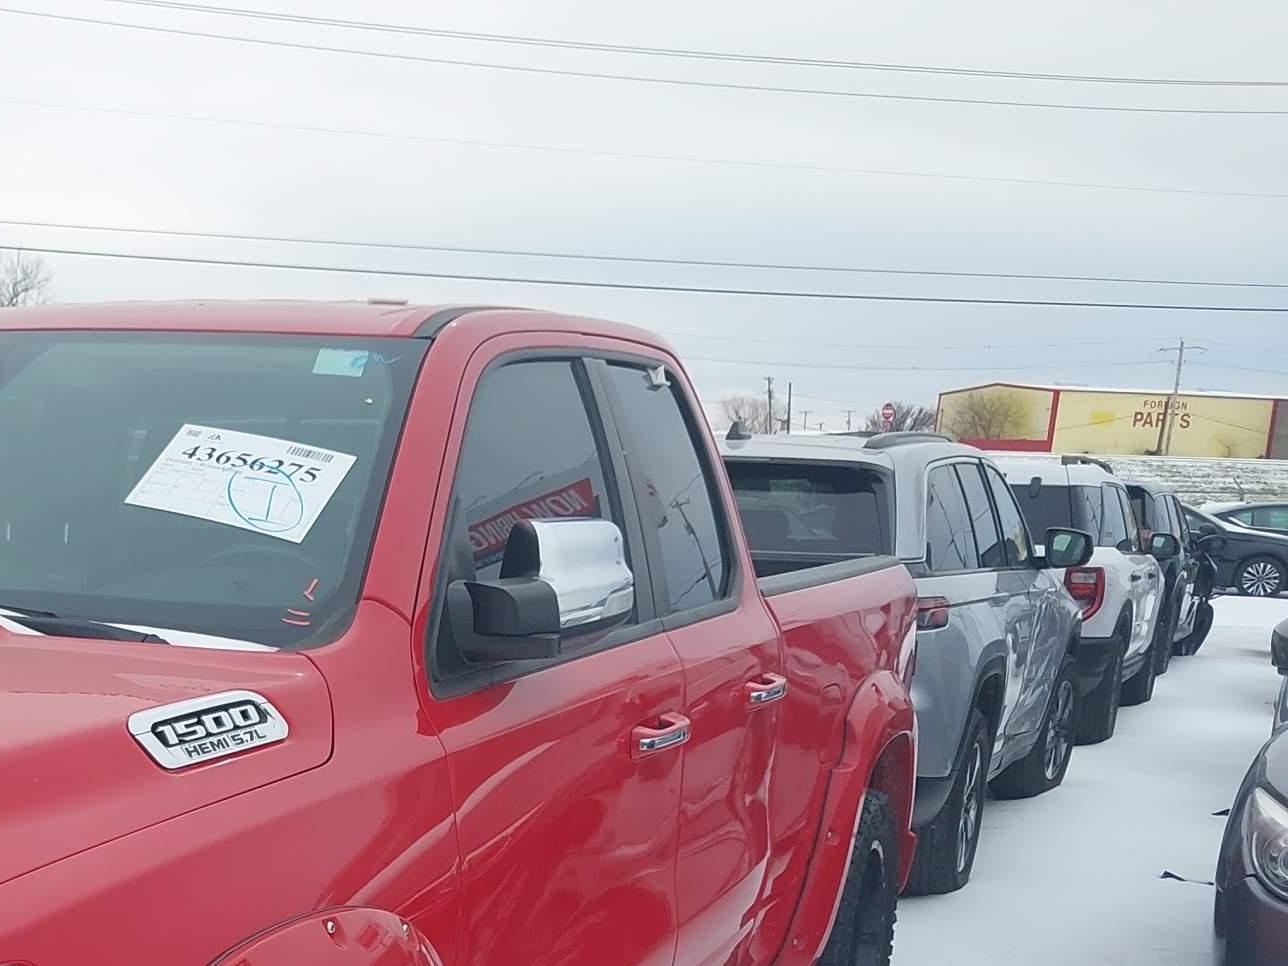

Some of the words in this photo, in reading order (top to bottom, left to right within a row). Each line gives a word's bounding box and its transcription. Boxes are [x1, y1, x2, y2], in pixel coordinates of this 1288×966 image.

[1143, 400, 1188, 410] FORIGN
[181, 444, 322, 484] 43656275
[156, 703, 261, 746] 1500
[184, 738, 230, 758] HEMI
[231, 729, 267, 746] 5.7L
